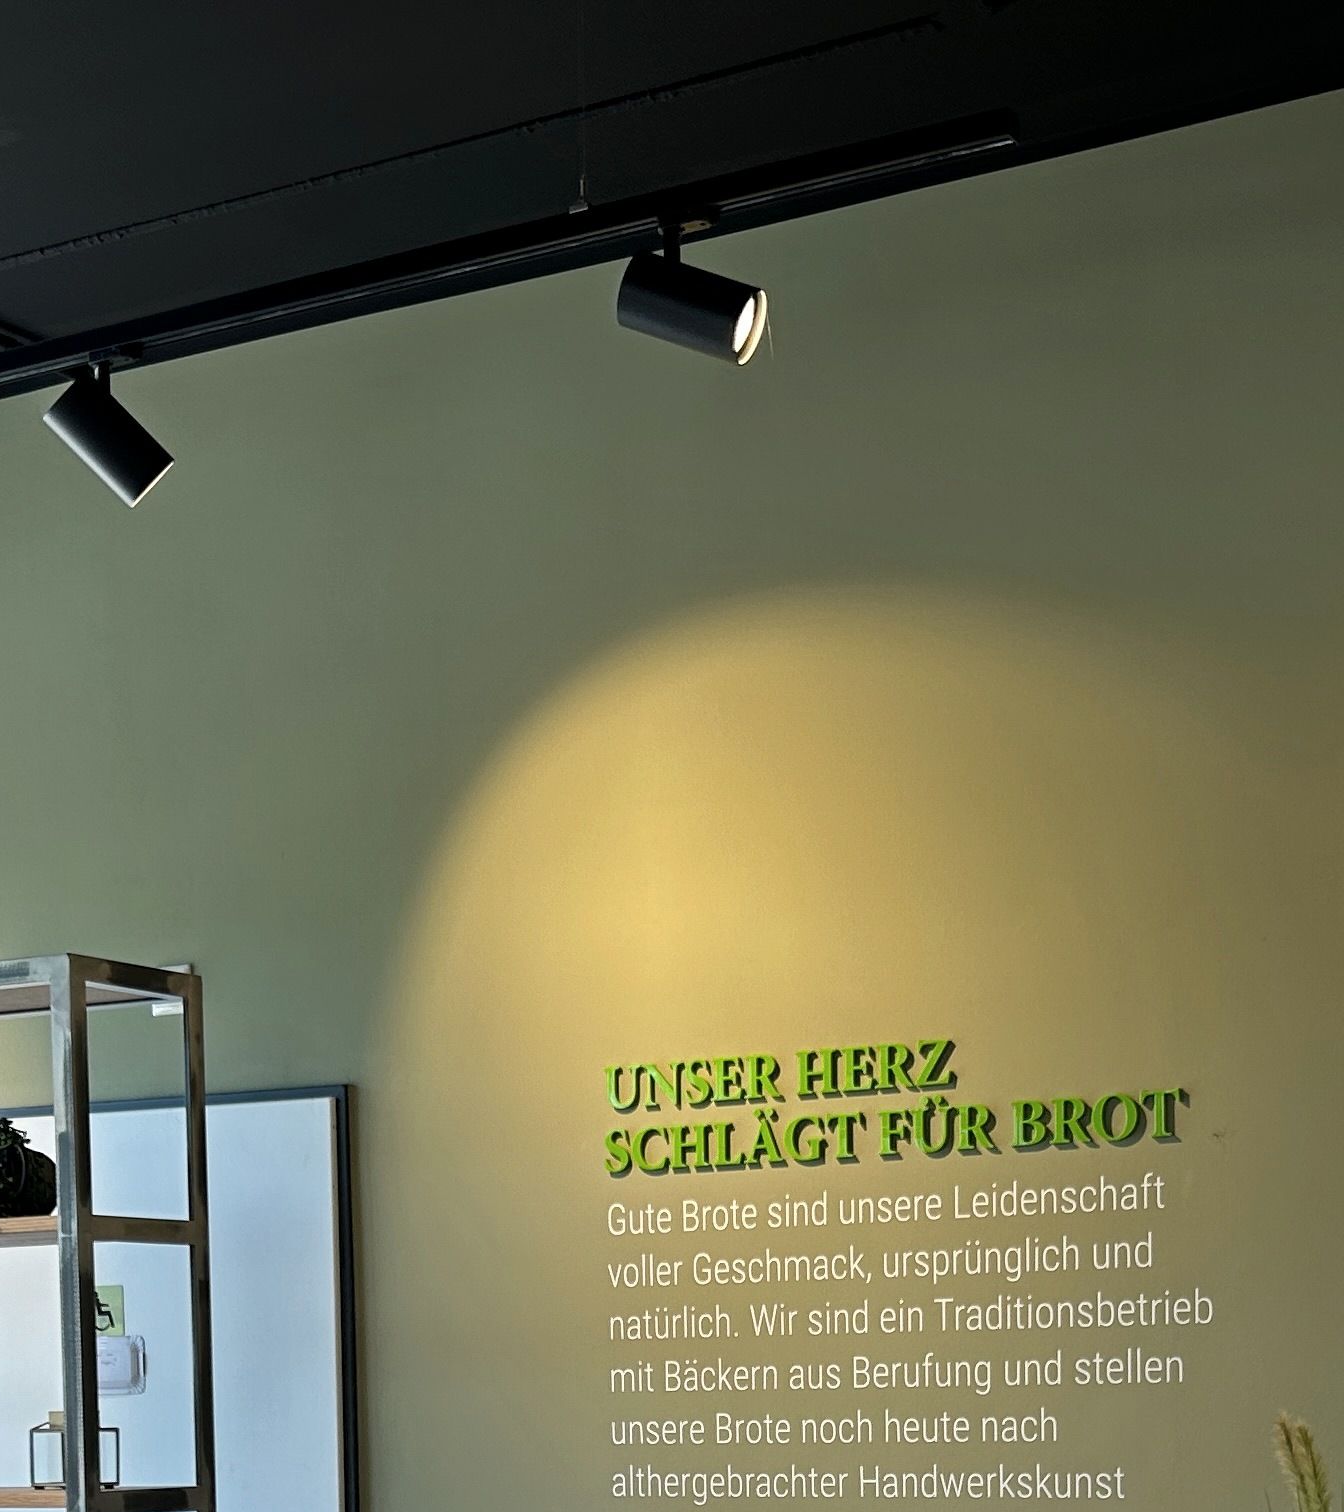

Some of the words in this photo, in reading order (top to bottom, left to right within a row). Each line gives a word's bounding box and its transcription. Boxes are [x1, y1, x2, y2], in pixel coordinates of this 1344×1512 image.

[604, 1051, 782, 1113] UNSER
[796, 1039, 959, 1098] HERZ
[604, 1107, 866, 1177] SCHLÄGT
[878, 1096, 1002, 1158] FÜR
[1010, 1086, 1188, 1147] BROT
[607, 1202, 673, 1236] Gute
[682, 1199, 758, 1233] Brote
[767, 1189, 828, 1229] sind
[839, 1193, 943, 1225] unsere
[954, 1171, 1166, 1219] Leidenschaft
[607, 1252, 684, 1288] voller
[692, 1243, 873, 1286] Geschmack,
[883, 1234, 1081, 1286] ursprünglich
[1092, 1231, 1153, 1270] und
[609, 1303, 739, 1341] natürlich.
[749, 1303, 799, 1337] Wir
[807, 1298, 869, 1336] sind
[879, 1297, 924, 1334] ein
[933, 1287, 1214, 1332] Traditionsbetrieb
[610, 1359, 655, 1393] mit
[664, 1357, 778, 1392] Bäckern
[789, 1363, 842, 1390] aus
[852, 1351, 993, 1396] Berufung
[1004, 1348, 1062, 1387] und
[1074, 1346, 1184, 1385] stellen
[611, 1419, 705, 1445] unsere
[715, 1412, 791, 1445] Brote
[801, 1408, 874, 1444] noch
[884, 1407, 970, 1444] heute
[981, 1406, 1058, 1443] nach
[611, 1463, 849, 1506] althergebrachter
[859, 1463, 1126, 1500] Handwerkskunst
